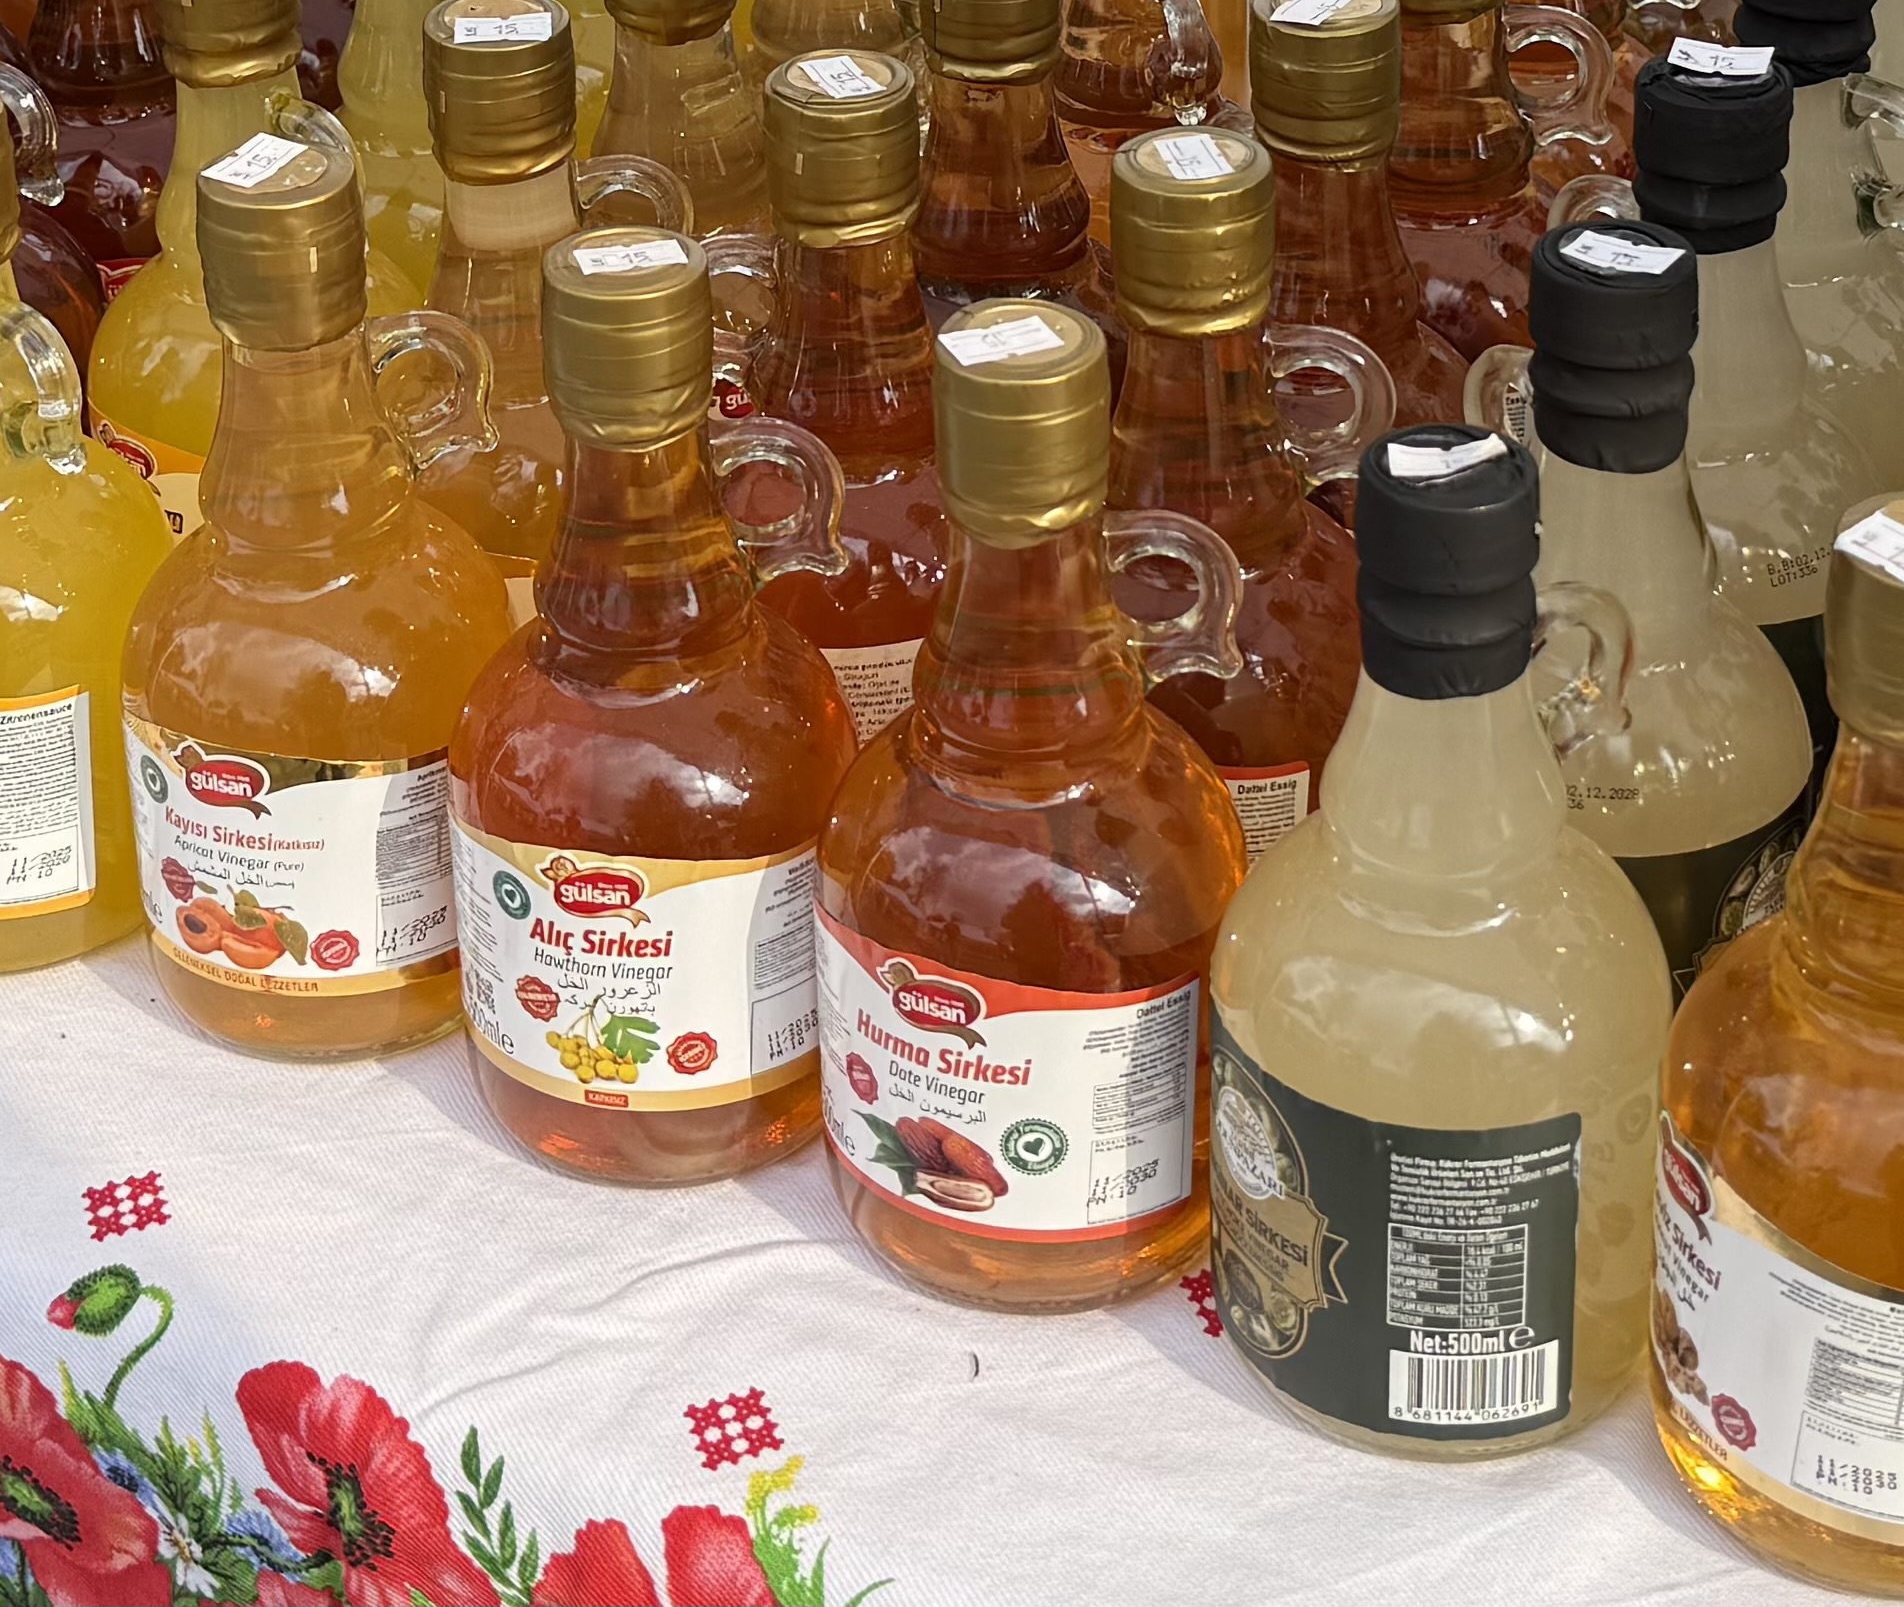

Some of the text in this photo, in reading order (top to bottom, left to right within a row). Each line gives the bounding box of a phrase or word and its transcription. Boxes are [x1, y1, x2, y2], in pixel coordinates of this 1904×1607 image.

[190, 770, 254, 799] gülsan
[166, 807, 207, 840] Kayısı
[213, 821, 272, 852] Sirkesi
[174, 834, 214, 859] Apricot
[218, 849, 269, 872] Vinegar
[560, 881, 631, 906] gülsan
[529, 917, 674, 958] Alıç Sirkesi
[534, 947, 673, 982] Hawthorn Vinegar
[898, 991, 967, 1025] gülsan
[856, 1008, 930, 1068] Hurma
[936, 1048, 1033, 1086] Sirkesi
[889, 1060, 986, 1105] Date Vinegar
[1245, 1207, 1309, 1268] SİRKESİ
[1672, 1223, 1722, 1291] Sirkesi
[1410, 1328, 1506, 1355] Net:500ml
[1394, 1400, 1540, 1421] 8 681144 062691
